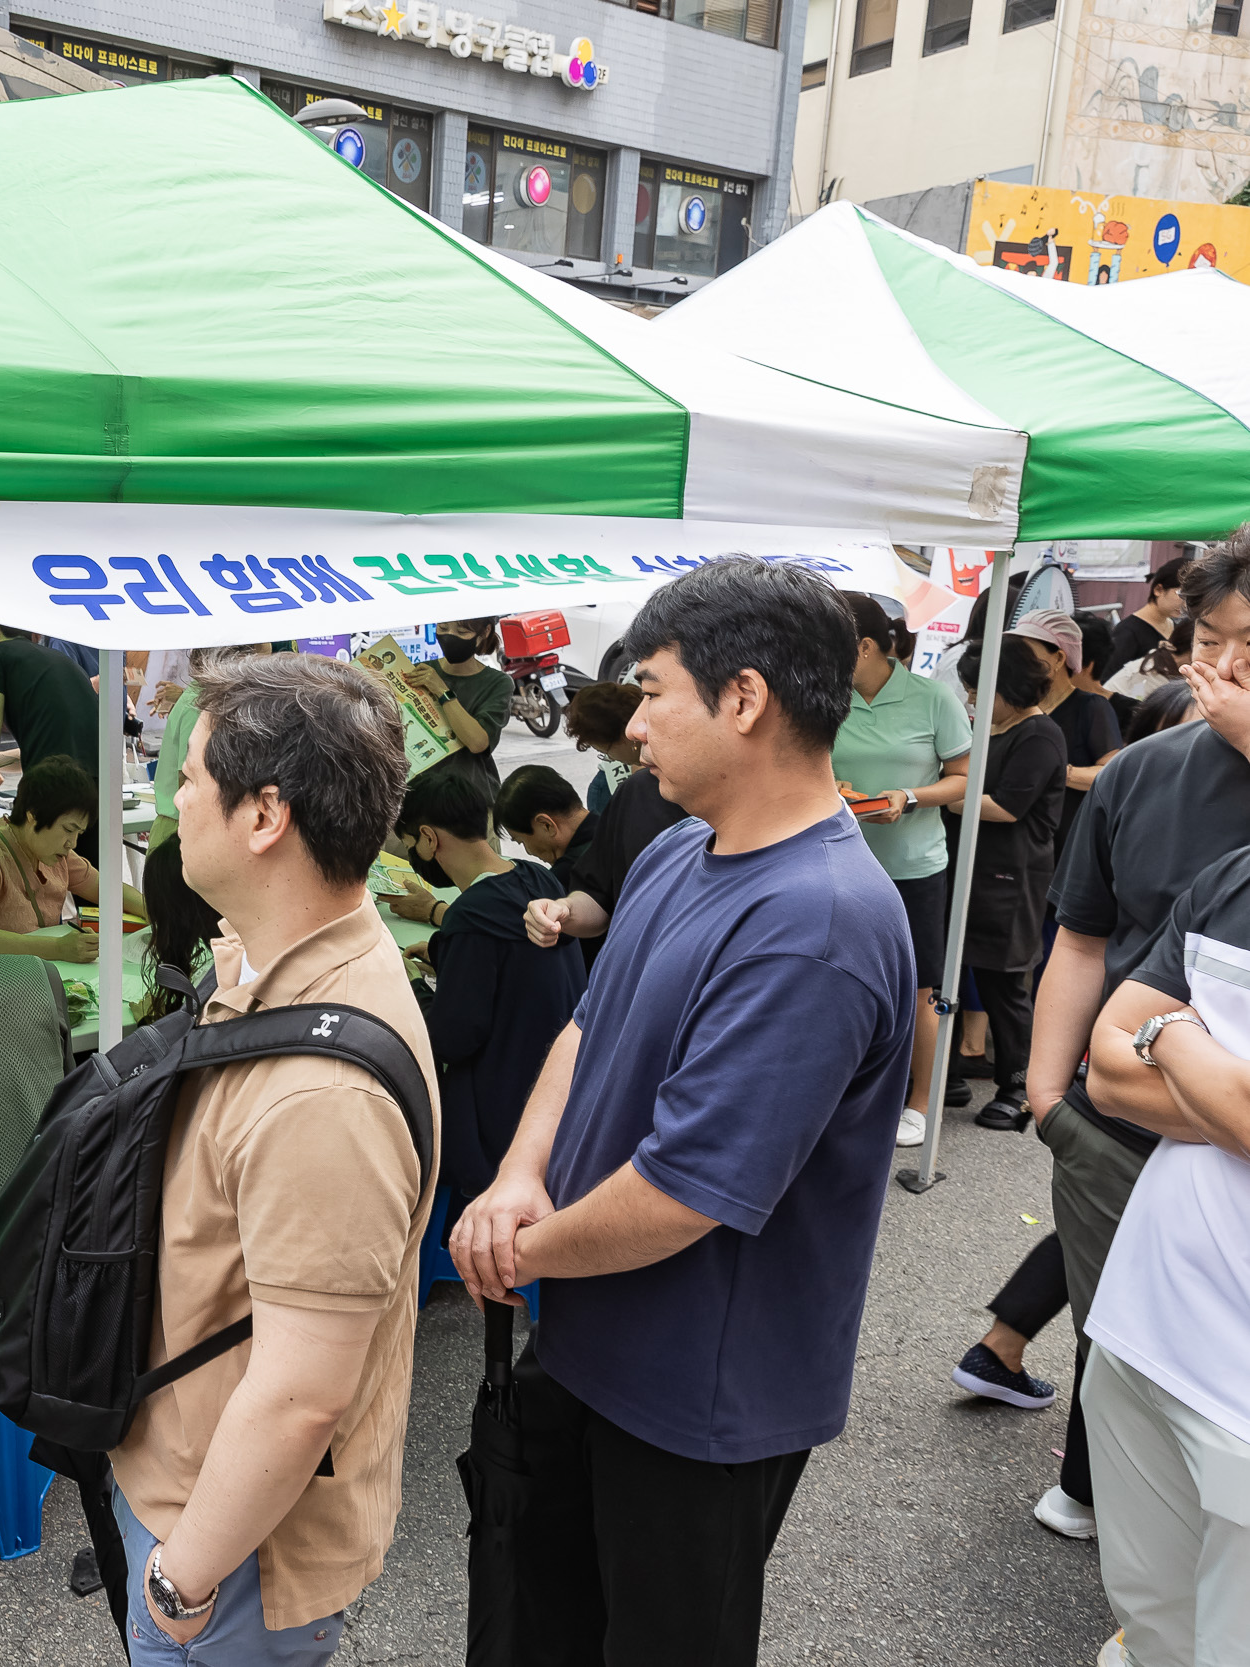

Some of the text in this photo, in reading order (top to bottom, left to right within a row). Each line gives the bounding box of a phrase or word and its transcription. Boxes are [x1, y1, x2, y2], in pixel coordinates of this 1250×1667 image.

[32, 553, 213, 620] 우리
[199, 553, 375, 614] 함께
[352, 552, 647, 596] 건강생활
